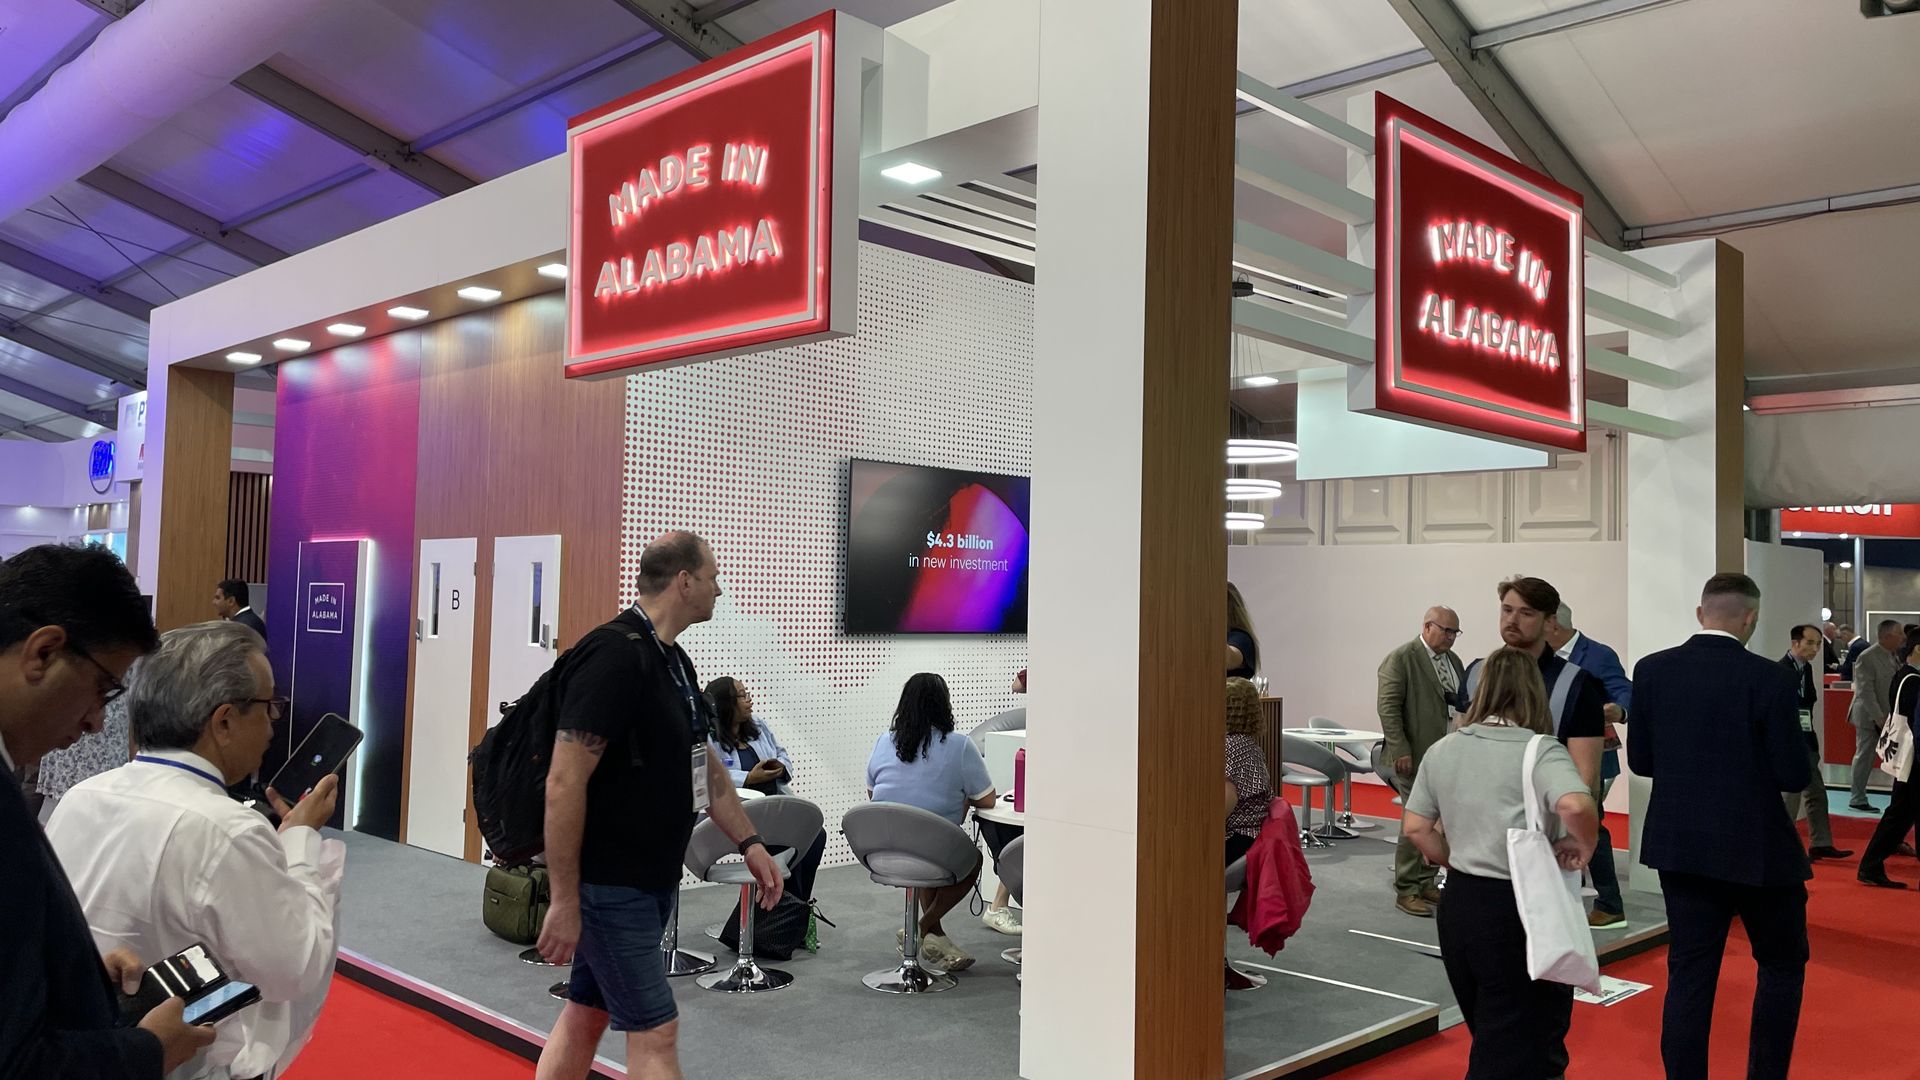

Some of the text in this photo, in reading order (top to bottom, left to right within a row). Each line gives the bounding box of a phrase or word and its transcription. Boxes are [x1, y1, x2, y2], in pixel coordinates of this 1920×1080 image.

[608, 142, 768, 227] MADE IN
[593, 218, 782, 298] ALABAMA
[1430, 220, 1553, 301] MADE IN
[1418, 292, 1562, 368] ALABAMA
[927, 530, 993, 550] $4.3 billion
[909, 553, 1008, 571] in new investment
[314, 594, 337, 606] MADE IN
[451, 589, 460, 610] B
[311, 610, 338, 620] ALABAMA
